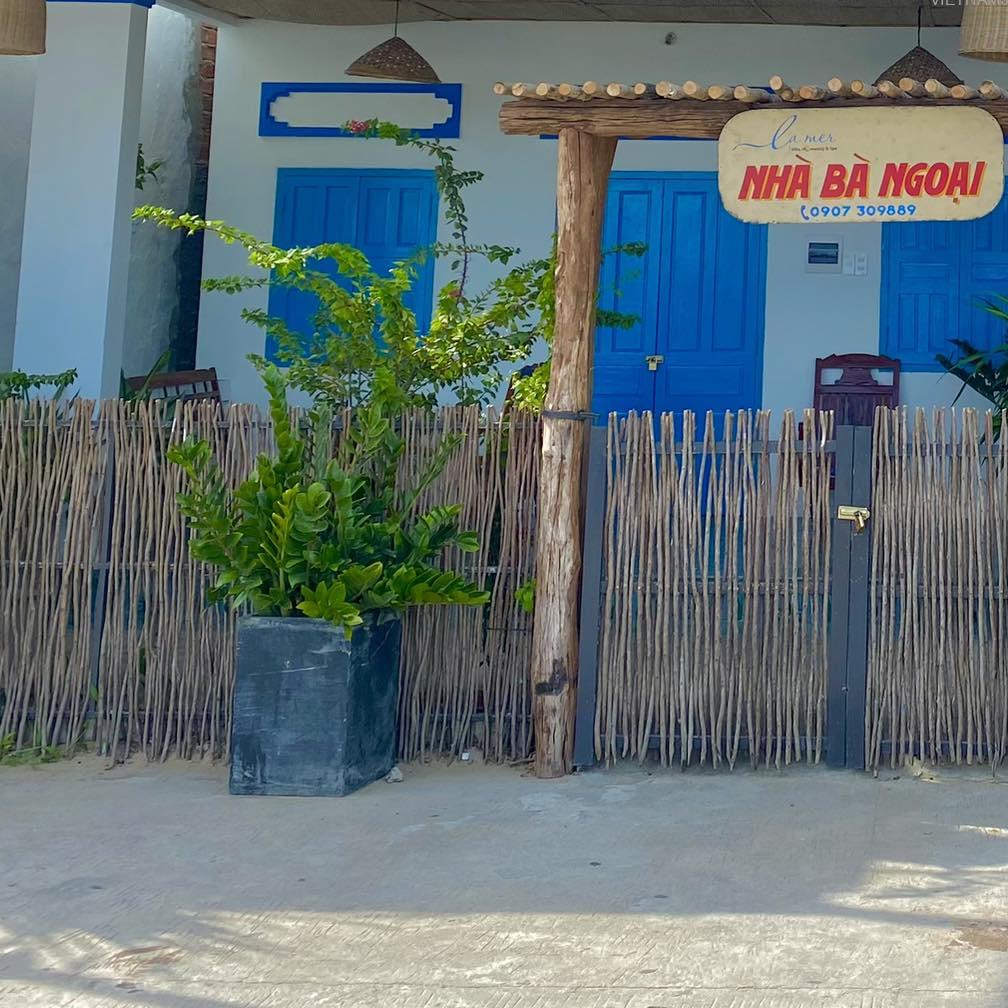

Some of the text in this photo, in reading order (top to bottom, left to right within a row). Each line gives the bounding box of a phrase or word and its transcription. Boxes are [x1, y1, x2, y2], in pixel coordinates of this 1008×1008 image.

[803, 133, 834, 144] mer
[737, 153, 988, 205] NHÀ BÀ NGOẠI
[810, 204, 917, 218] 0907 309889
